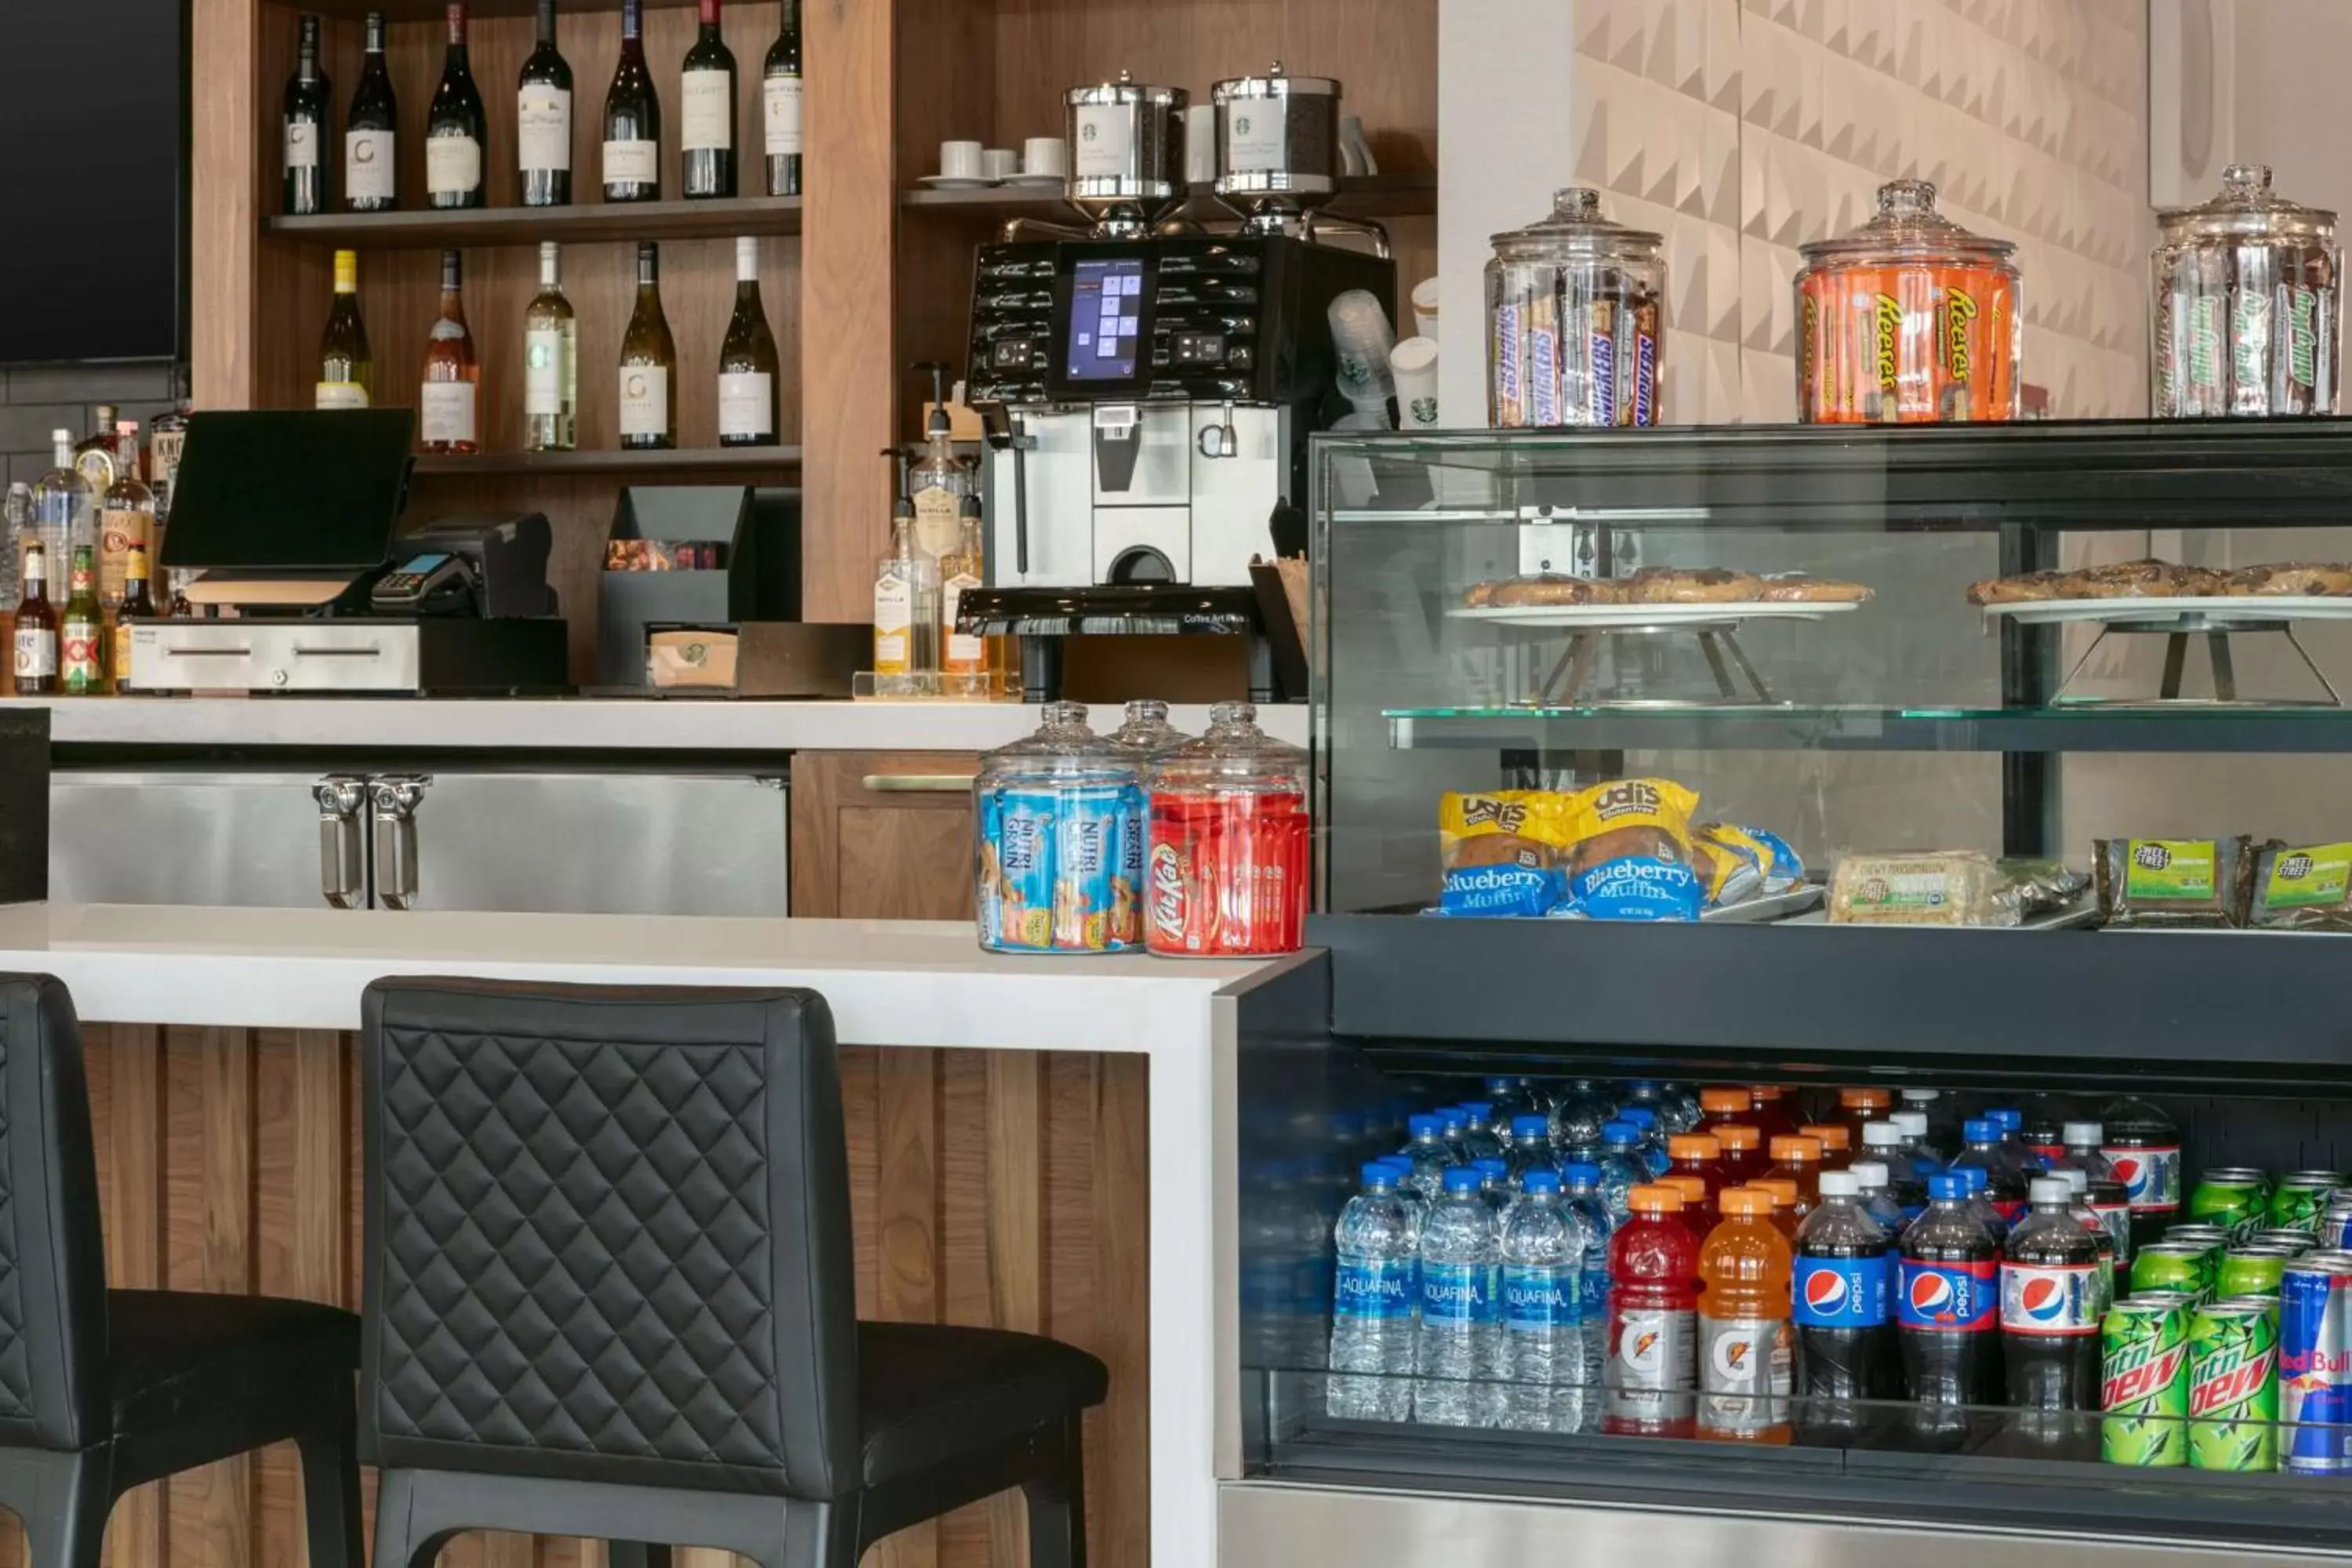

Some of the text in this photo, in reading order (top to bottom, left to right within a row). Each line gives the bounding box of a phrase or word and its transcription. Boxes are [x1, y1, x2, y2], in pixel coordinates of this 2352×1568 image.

[1636, 336, 1654, 426] SNICKERS
[1082, 822, 1098, 872] NUTRI
[2134, 854, 2169, 867] STREET
[2136, 845, 2169, 858] SWEET
[1584, 859, 1690, 895] Blueberry
[1342, 1277, 1402, 1296] AQUAFINA
[1850, 1272, 1864, 1314] pepsi
[1955, 1276, 1969, 1317] pepsi
[2313, 1352, 2350, 1372] Bull
